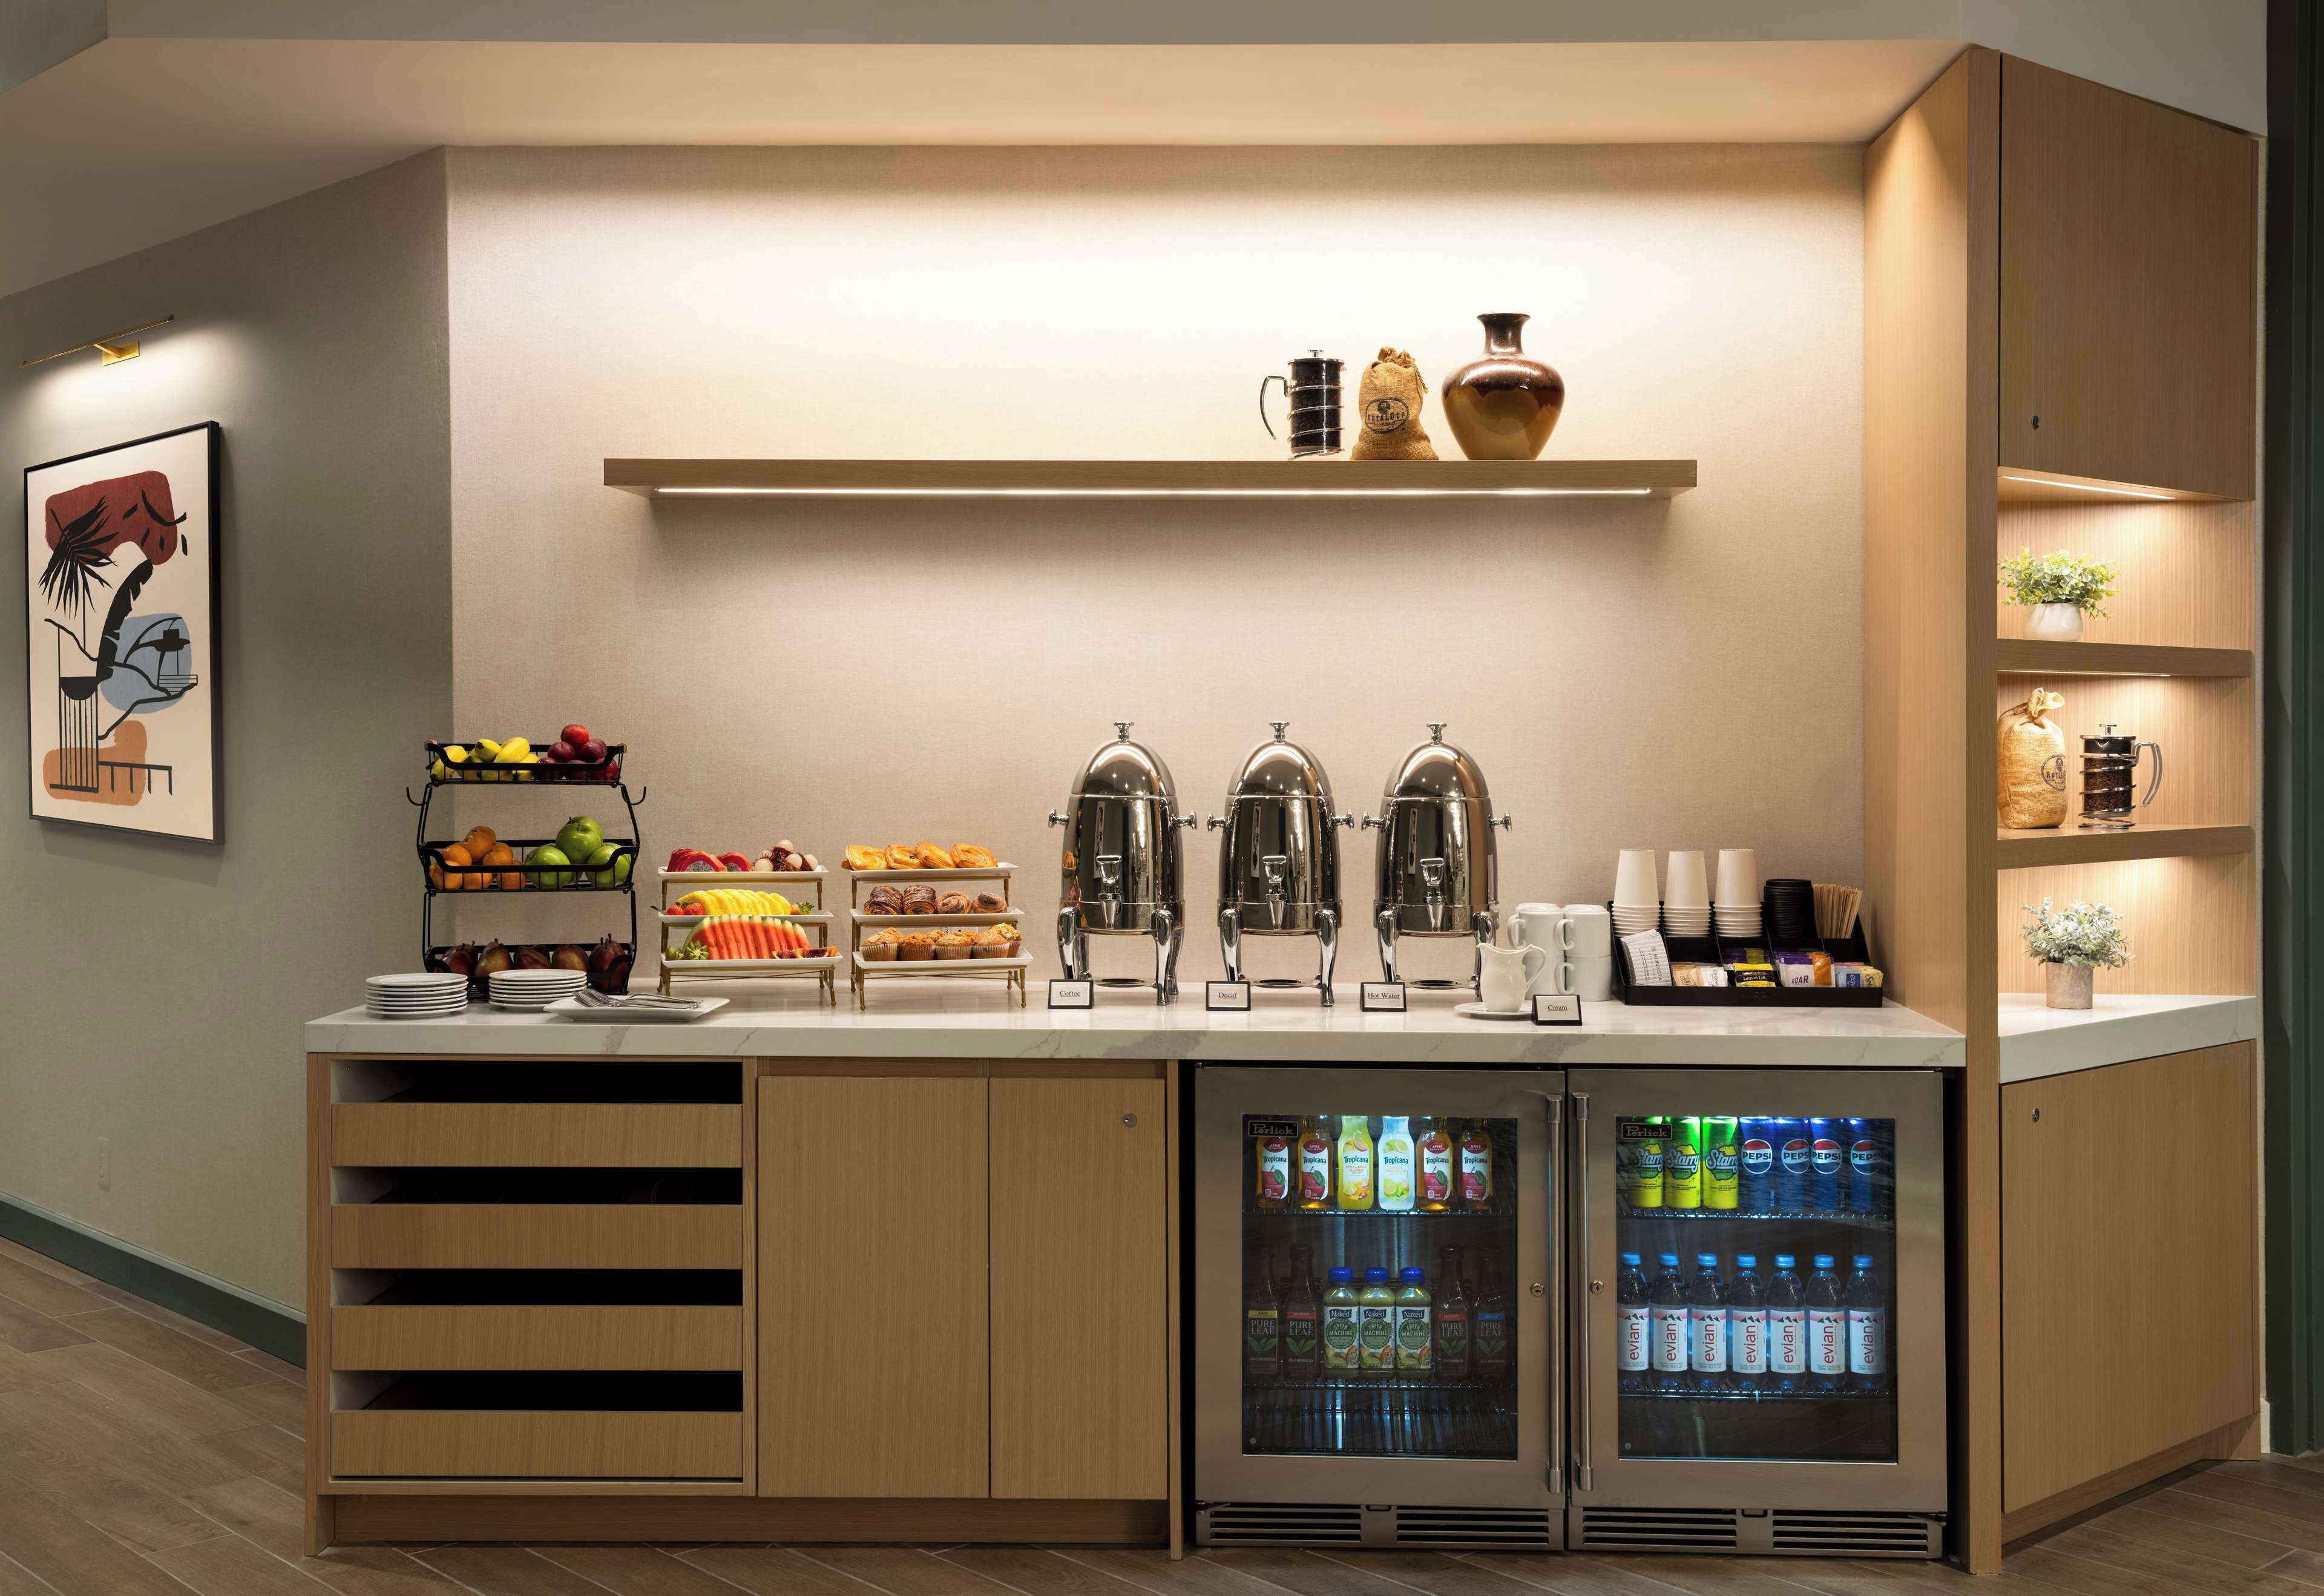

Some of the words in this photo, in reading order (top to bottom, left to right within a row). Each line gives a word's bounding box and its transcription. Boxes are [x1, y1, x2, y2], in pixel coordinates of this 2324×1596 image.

[1653, 953, 1663, 981] SONESTA
[1791, 975, 1809, 984] ROAR
[1252, 1123, 1294, 1134] Perlick
[1626, 1126, 1668, 1137] Perlick
[1666, 1149, 1700, 1174] Starry
[1742, 1152, 1771, 1160] PEPSI
[1812, 1152, 1840, 1160] PEPSI
[1628, 1322, 1640, 1361] evian
[1664, 1324, 1676, 1361] evian
[1702, 1324, 1715, 1362] evian
[1744, 1325, 1756, 1363] evian
[1782, 1325, 1794, 1363] evian
[1822, 1325, 1834, 1364] evian
[1862, 1325, 1874, 1364] evian
